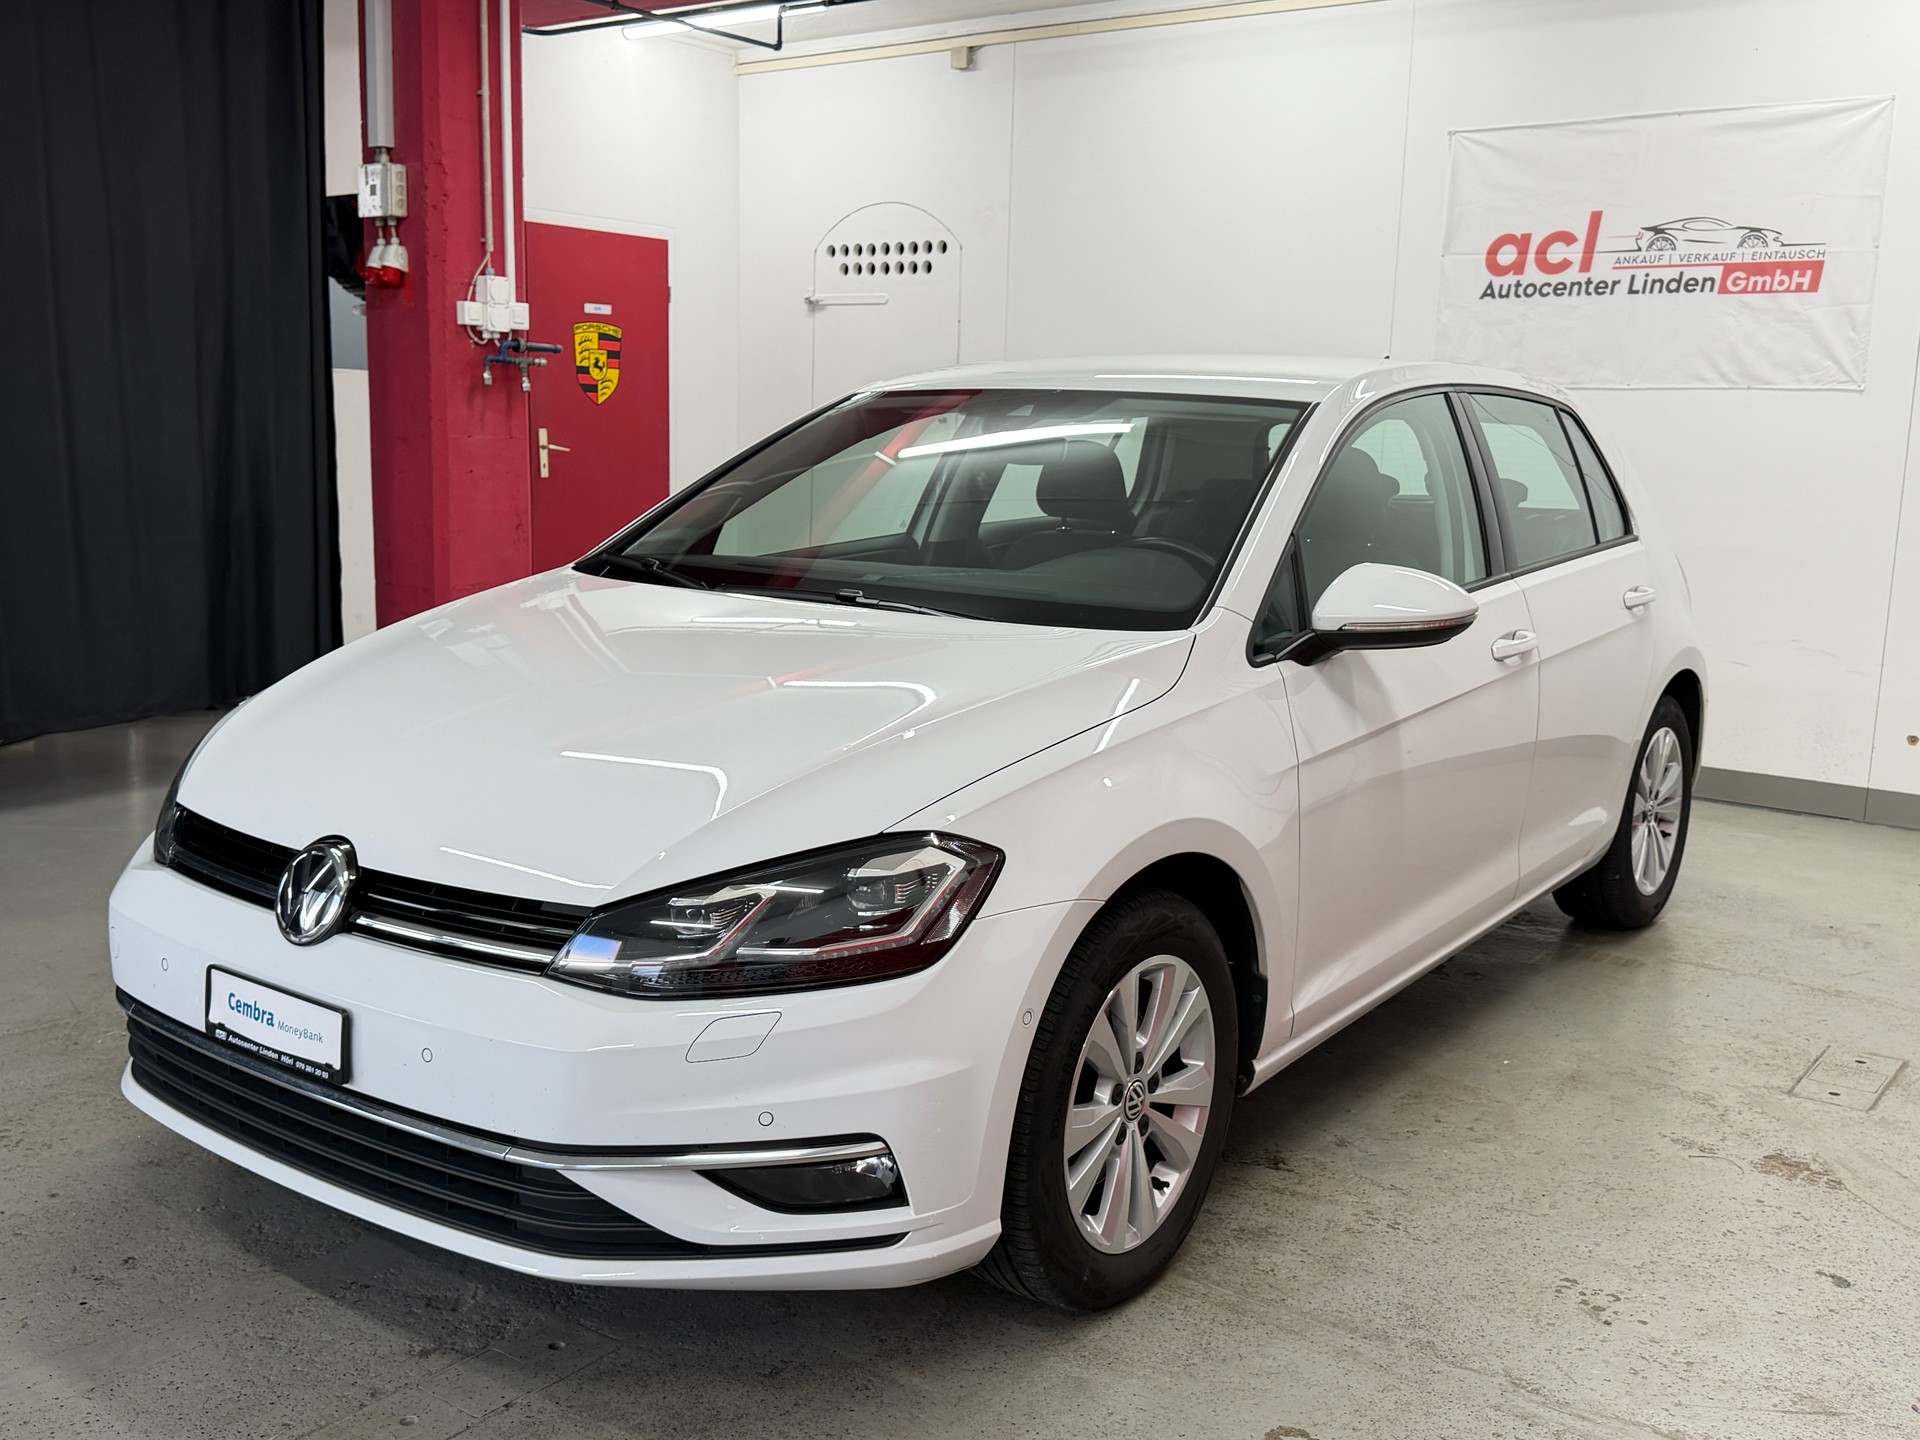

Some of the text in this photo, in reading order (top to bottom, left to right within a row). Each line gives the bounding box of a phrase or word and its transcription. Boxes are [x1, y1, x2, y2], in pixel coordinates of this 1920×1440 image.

[1485, 210, 1603, 277] acl
[1613, 249, 1826, 265] ANKAUF VERKAUF EINTAUSCH
[1479, 269, 1813, 300] Autocenter Linden GmbH
[228, 992, 324, 1043] Cembra MoneyBank
[228, 1034, 259, 1052] Autocenter
[259, 1045, 279, 1060] Linden
